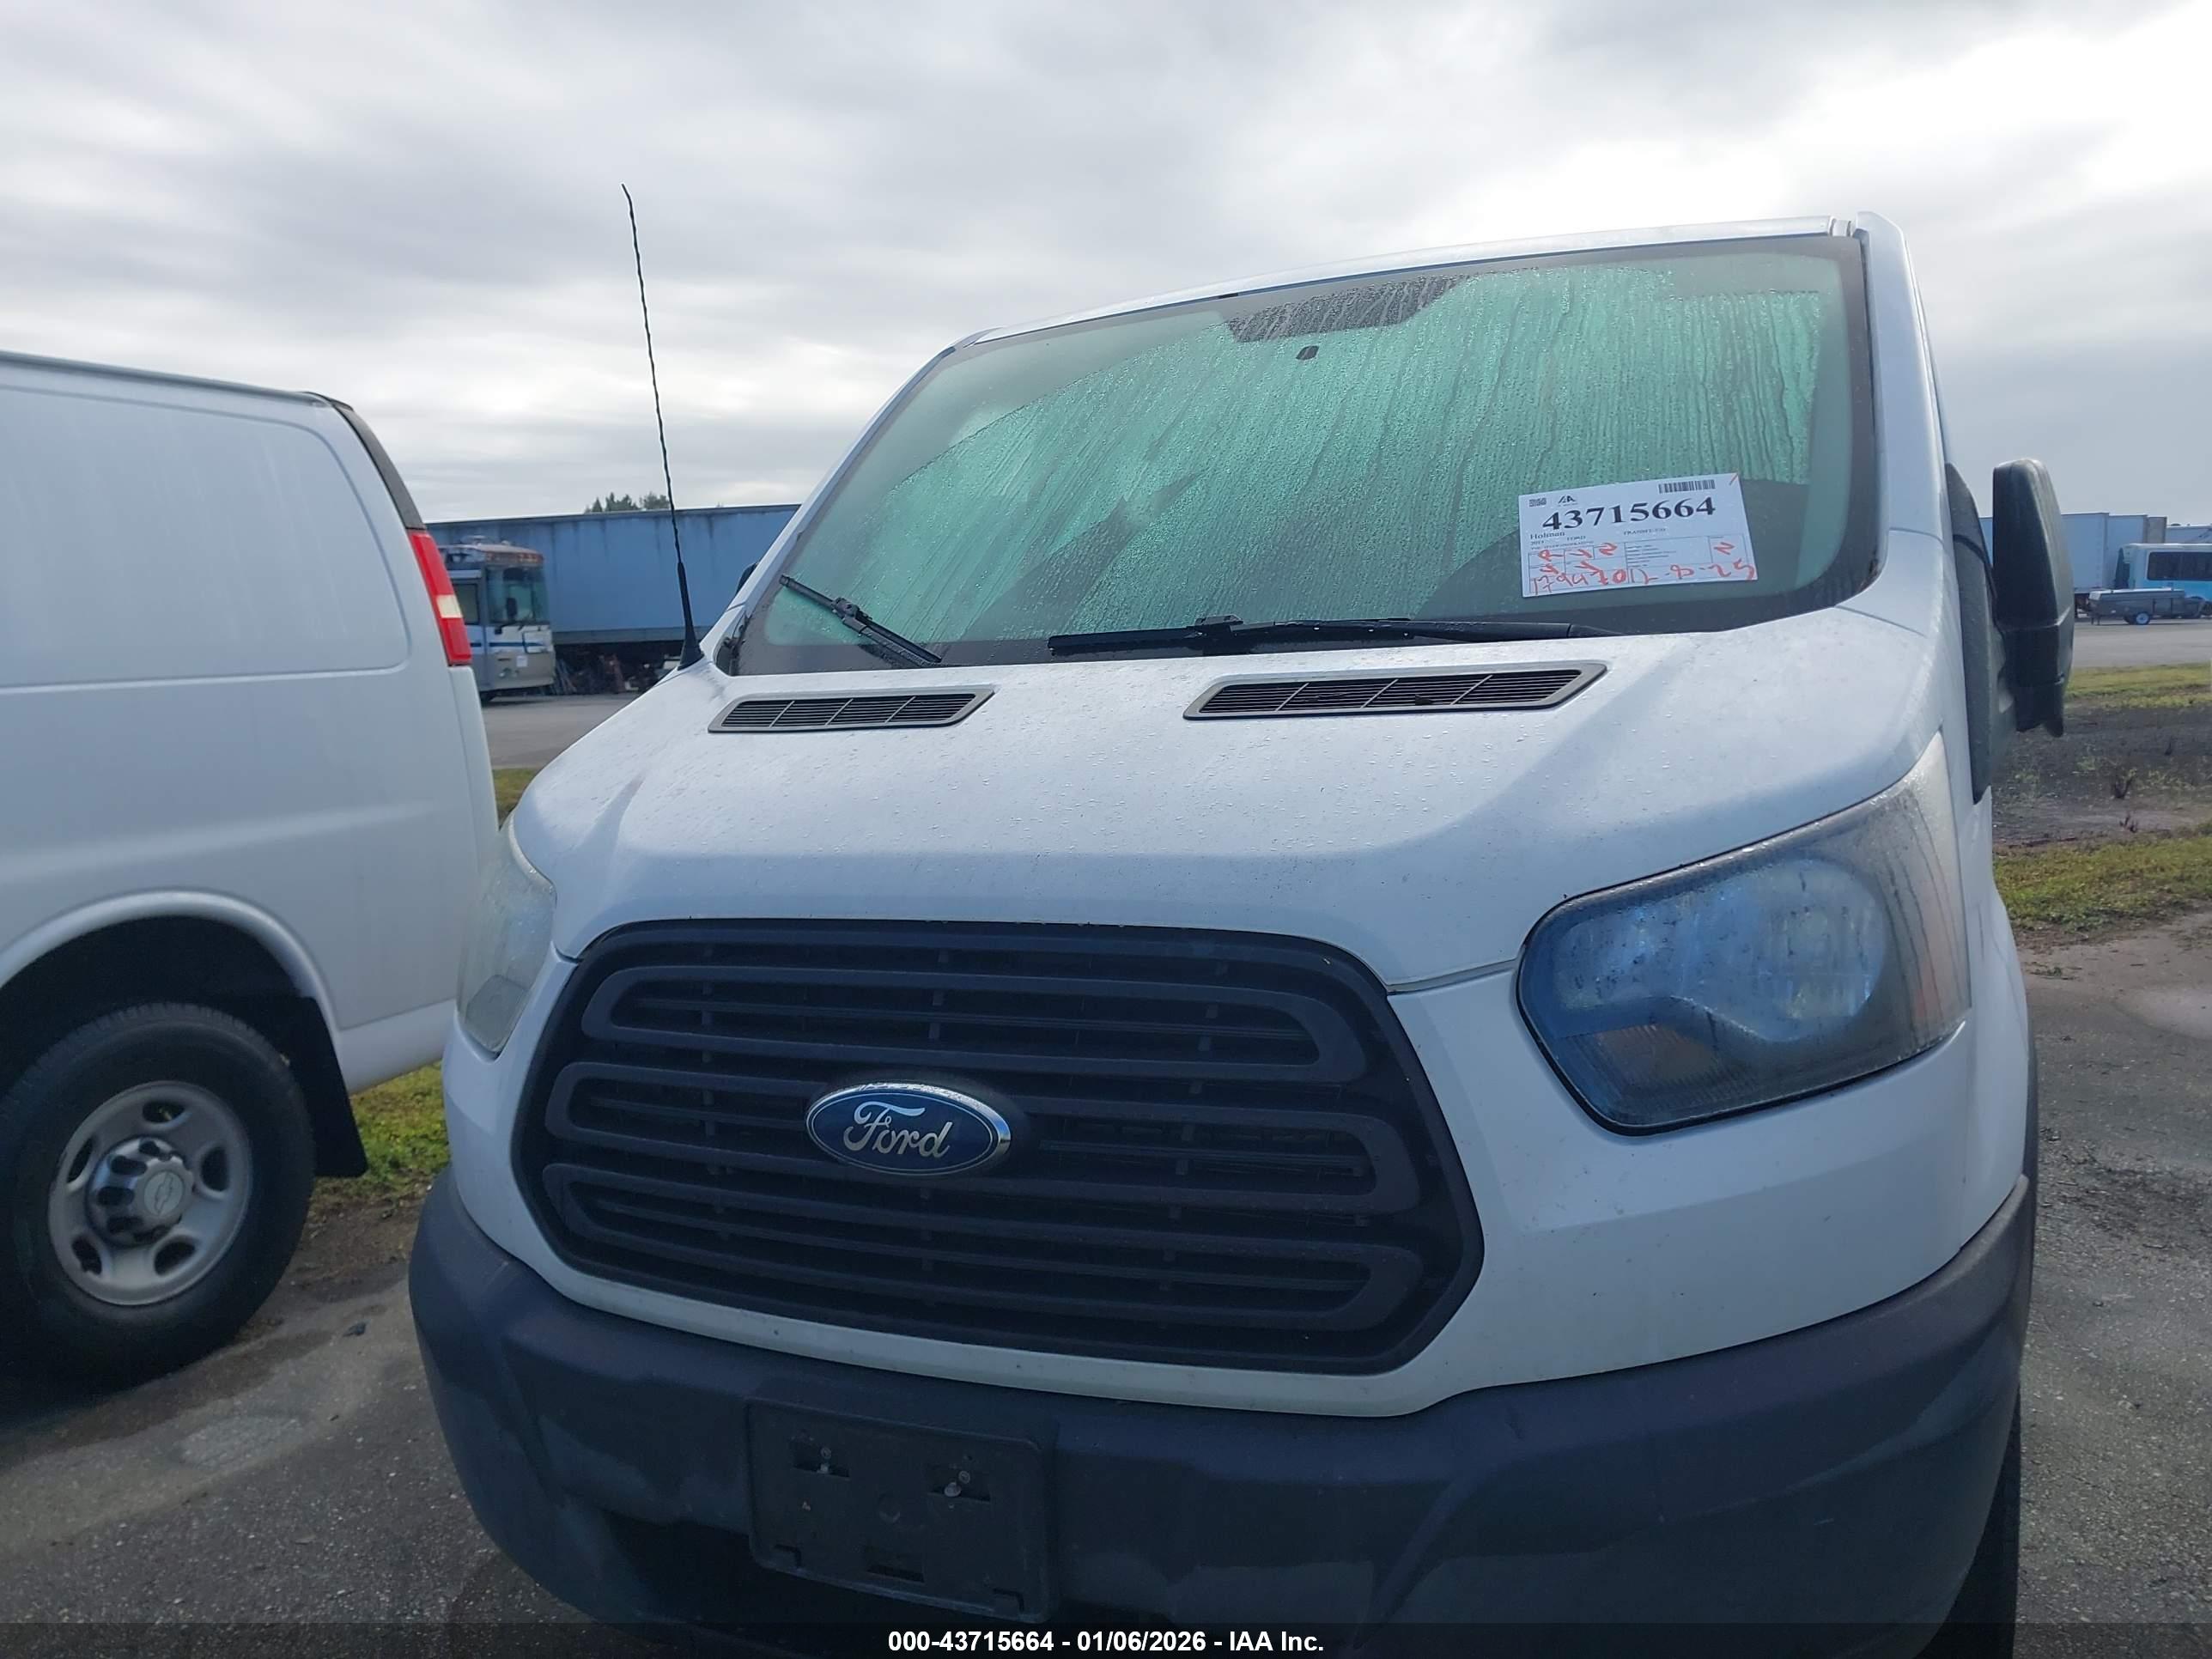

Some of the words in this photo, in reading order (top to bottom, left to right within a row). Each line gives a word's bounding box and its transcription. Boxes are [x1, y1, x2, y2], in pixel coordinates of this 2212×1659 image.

[1542, 496, 1717, 530] 43715664
[1530, 531, 1565, 539] Holman
[842, 1101, 953, 1158] Ford
